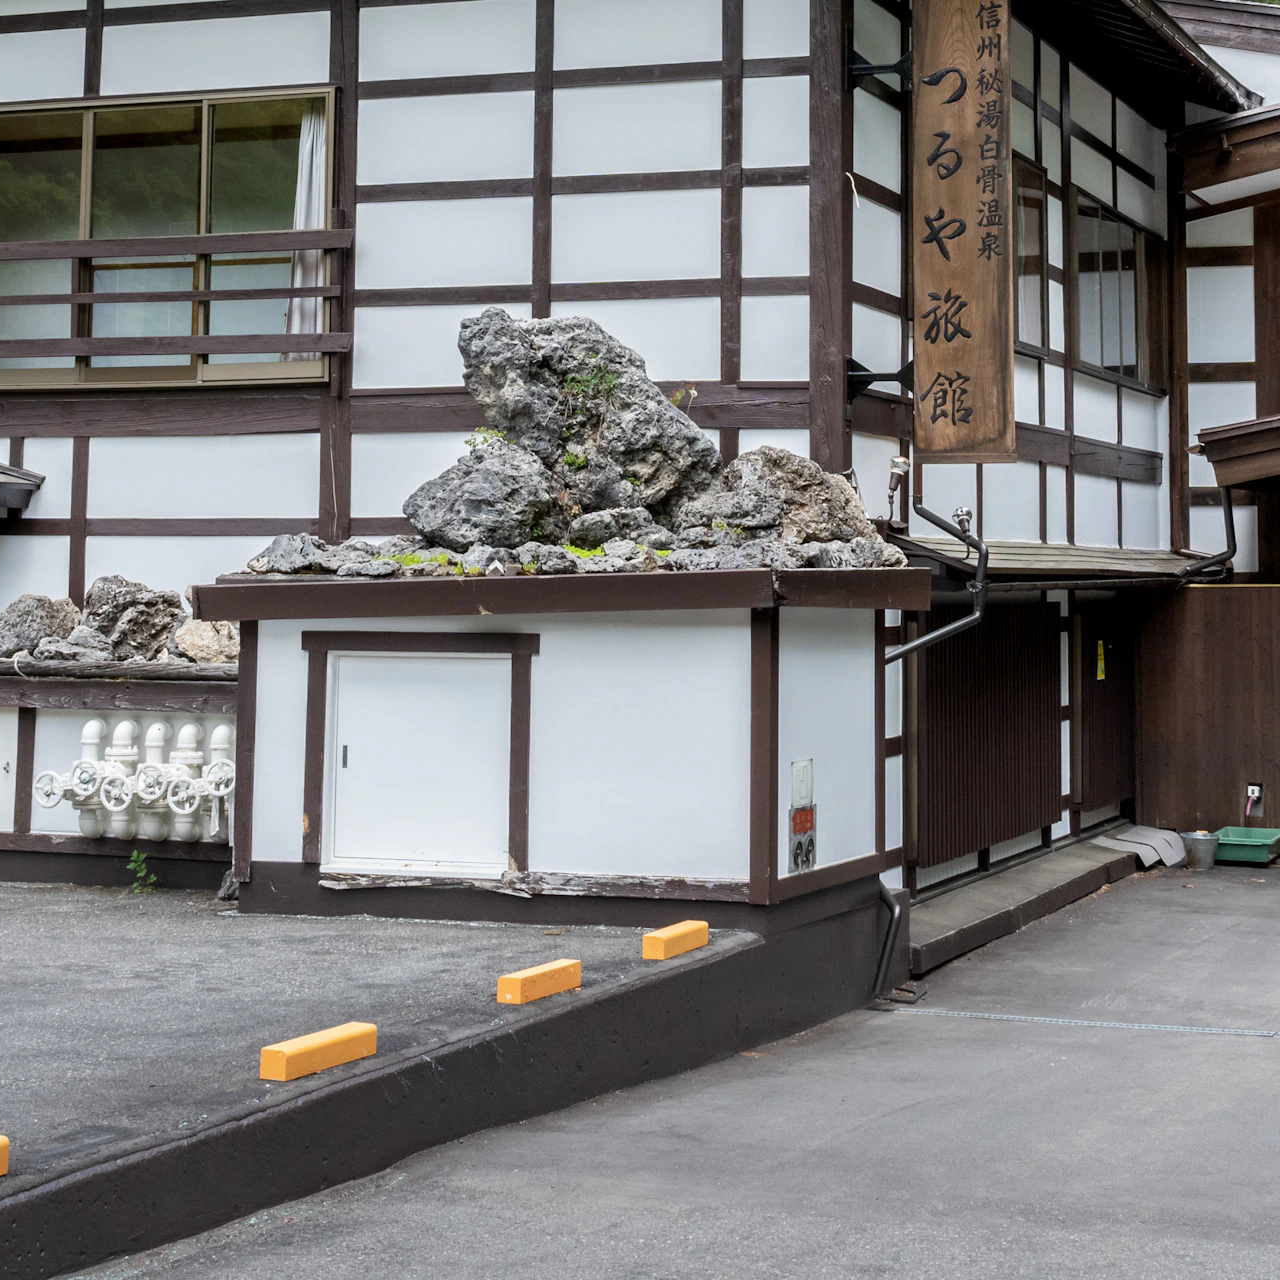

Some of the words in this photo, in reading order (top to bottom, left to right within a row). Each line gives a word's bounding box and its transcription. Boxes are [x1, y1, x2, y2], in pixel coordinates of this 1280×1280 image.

[921, 66, 973, 426] つるや旅館
[975, 1, 1004, 262] 信州秘湯白骨温泉
